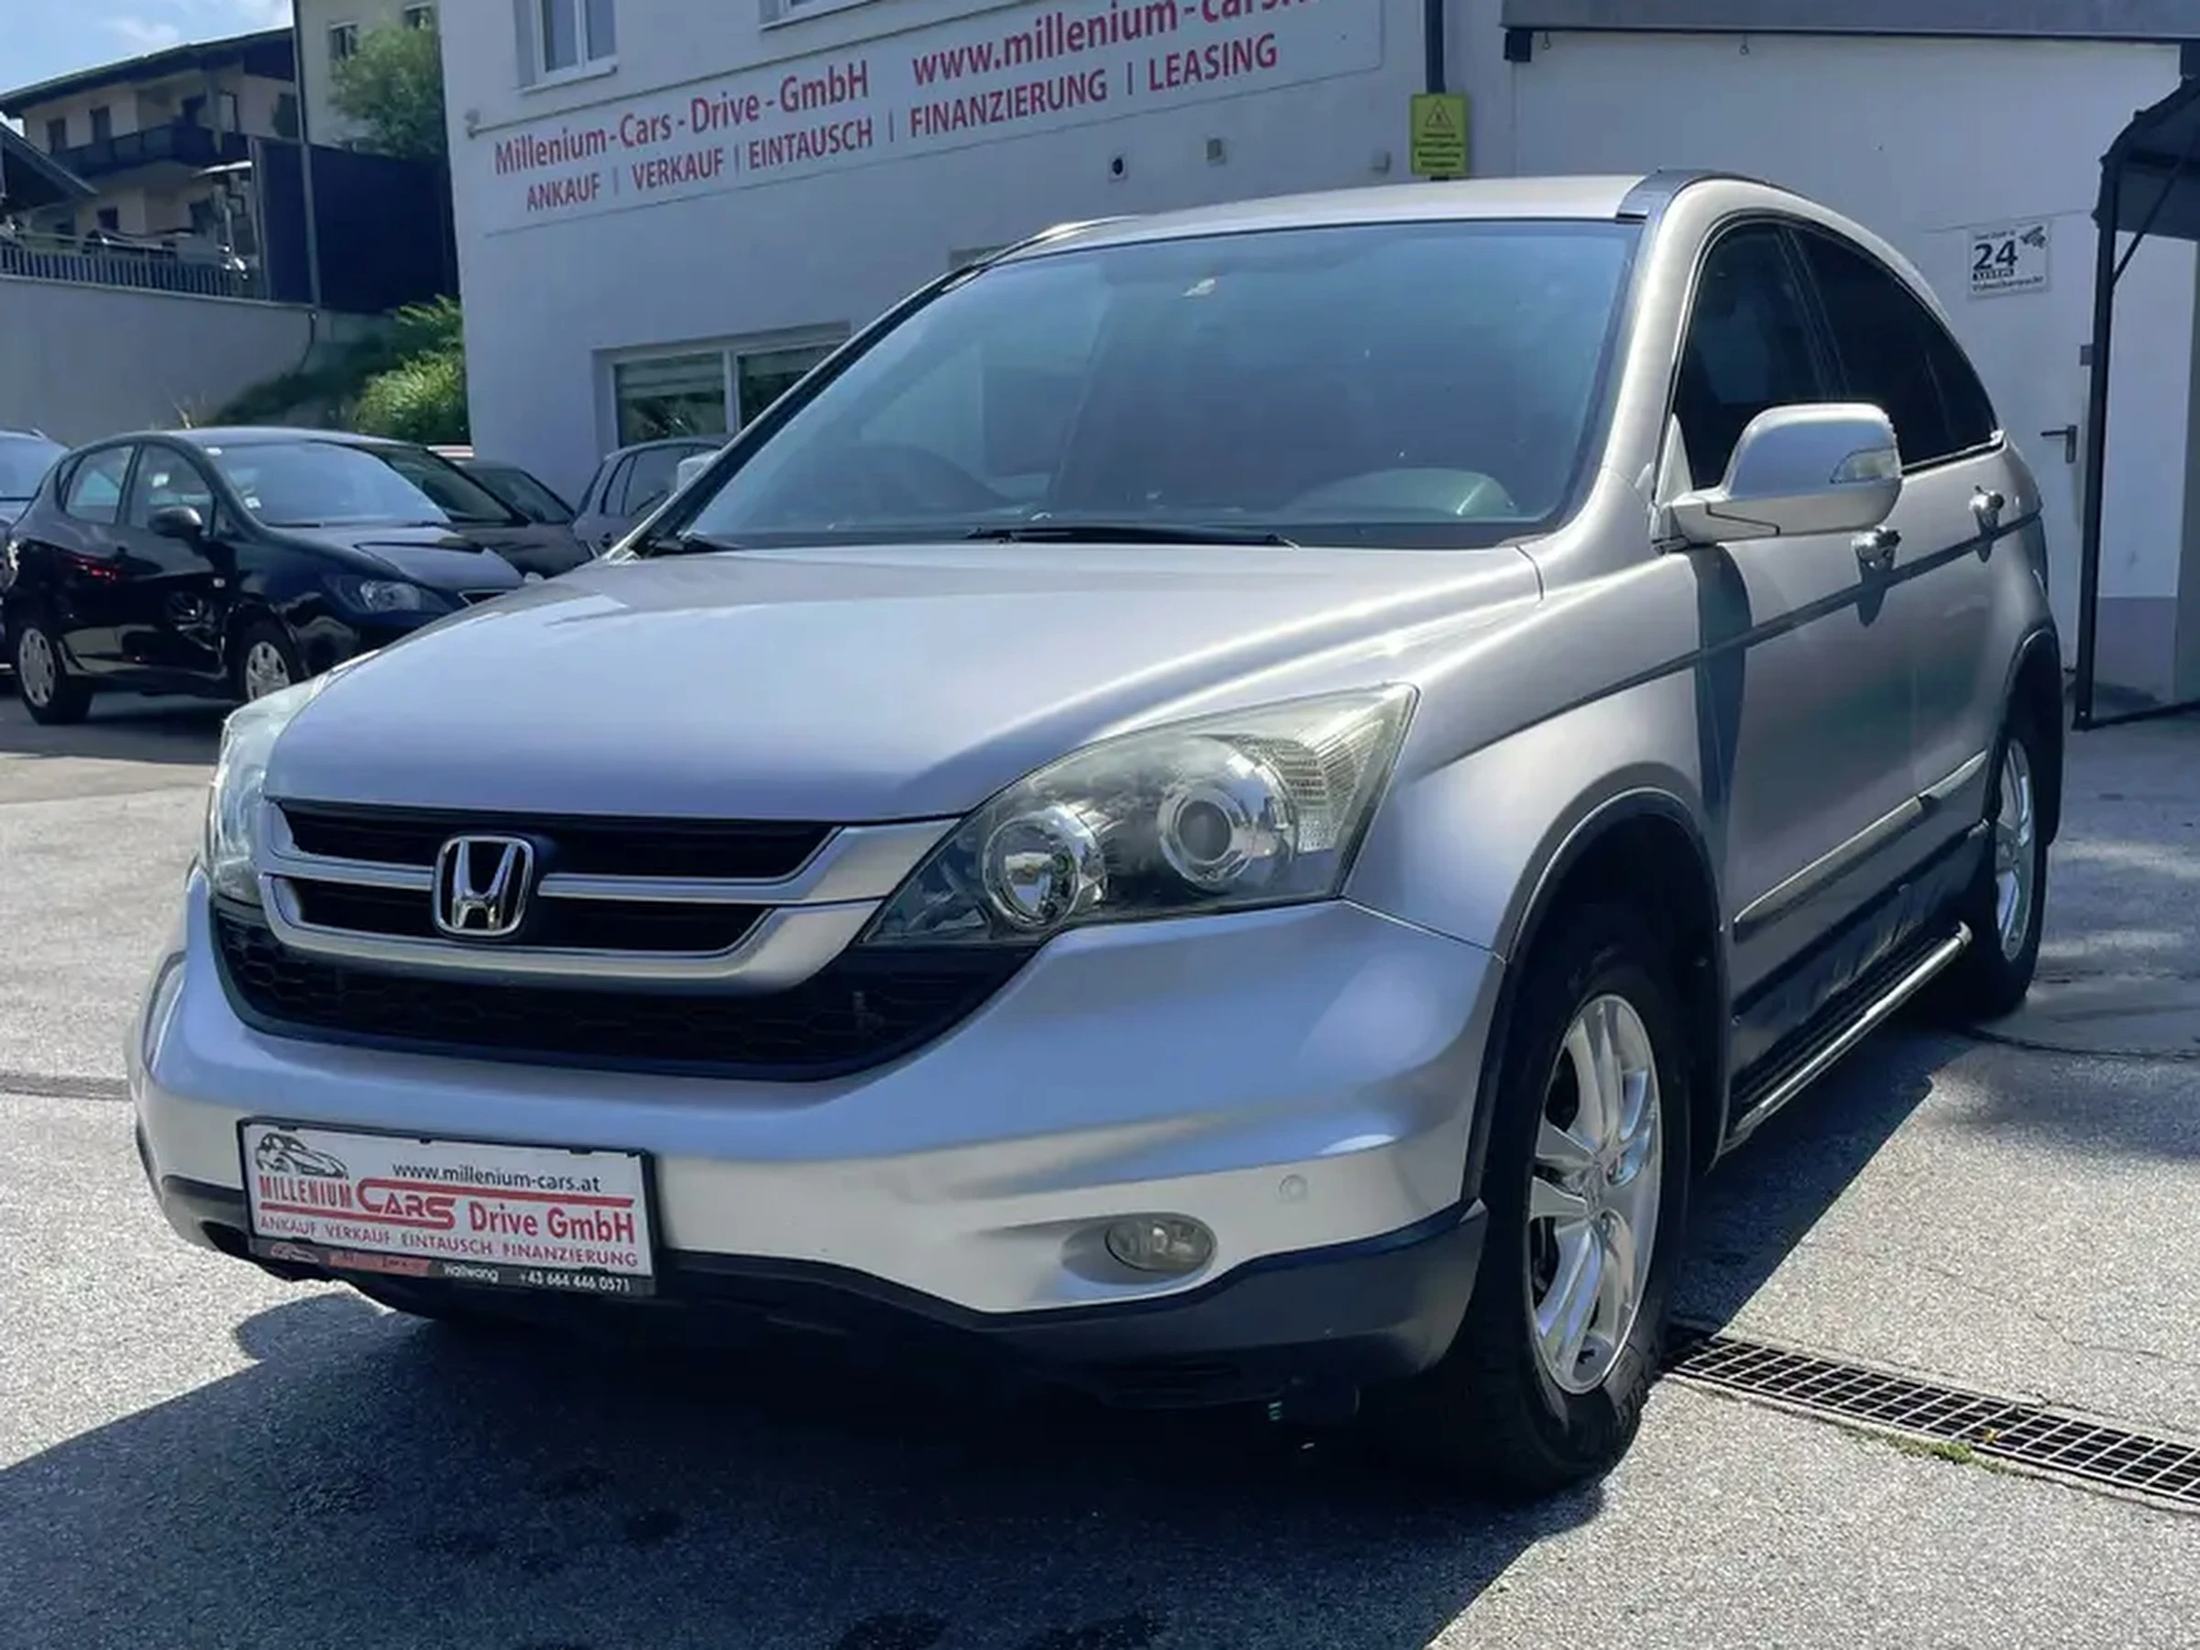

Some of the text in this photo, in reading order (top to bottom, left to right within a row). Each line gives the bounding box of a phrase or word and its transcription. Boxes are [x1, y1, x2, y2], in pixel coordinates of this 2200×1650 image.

[527, 32, 1277, 212] ANKAUF VERKAUF EINTAUSCH FINANZIERUNG LEASING
[1972, 240, 2018, 271] 24
[392, 1164, 602, 1193] www.millenium-cars.at
[259, 1175, 353, 1209] MILLENIUM
[469, 1201, 539, 1237] Drive
[547, 1207, 635, 1245] GmbH
[260, 1215, 638, 1268] ANKAUF VERKAUF EINTAUSCH FINANZIERUNG
